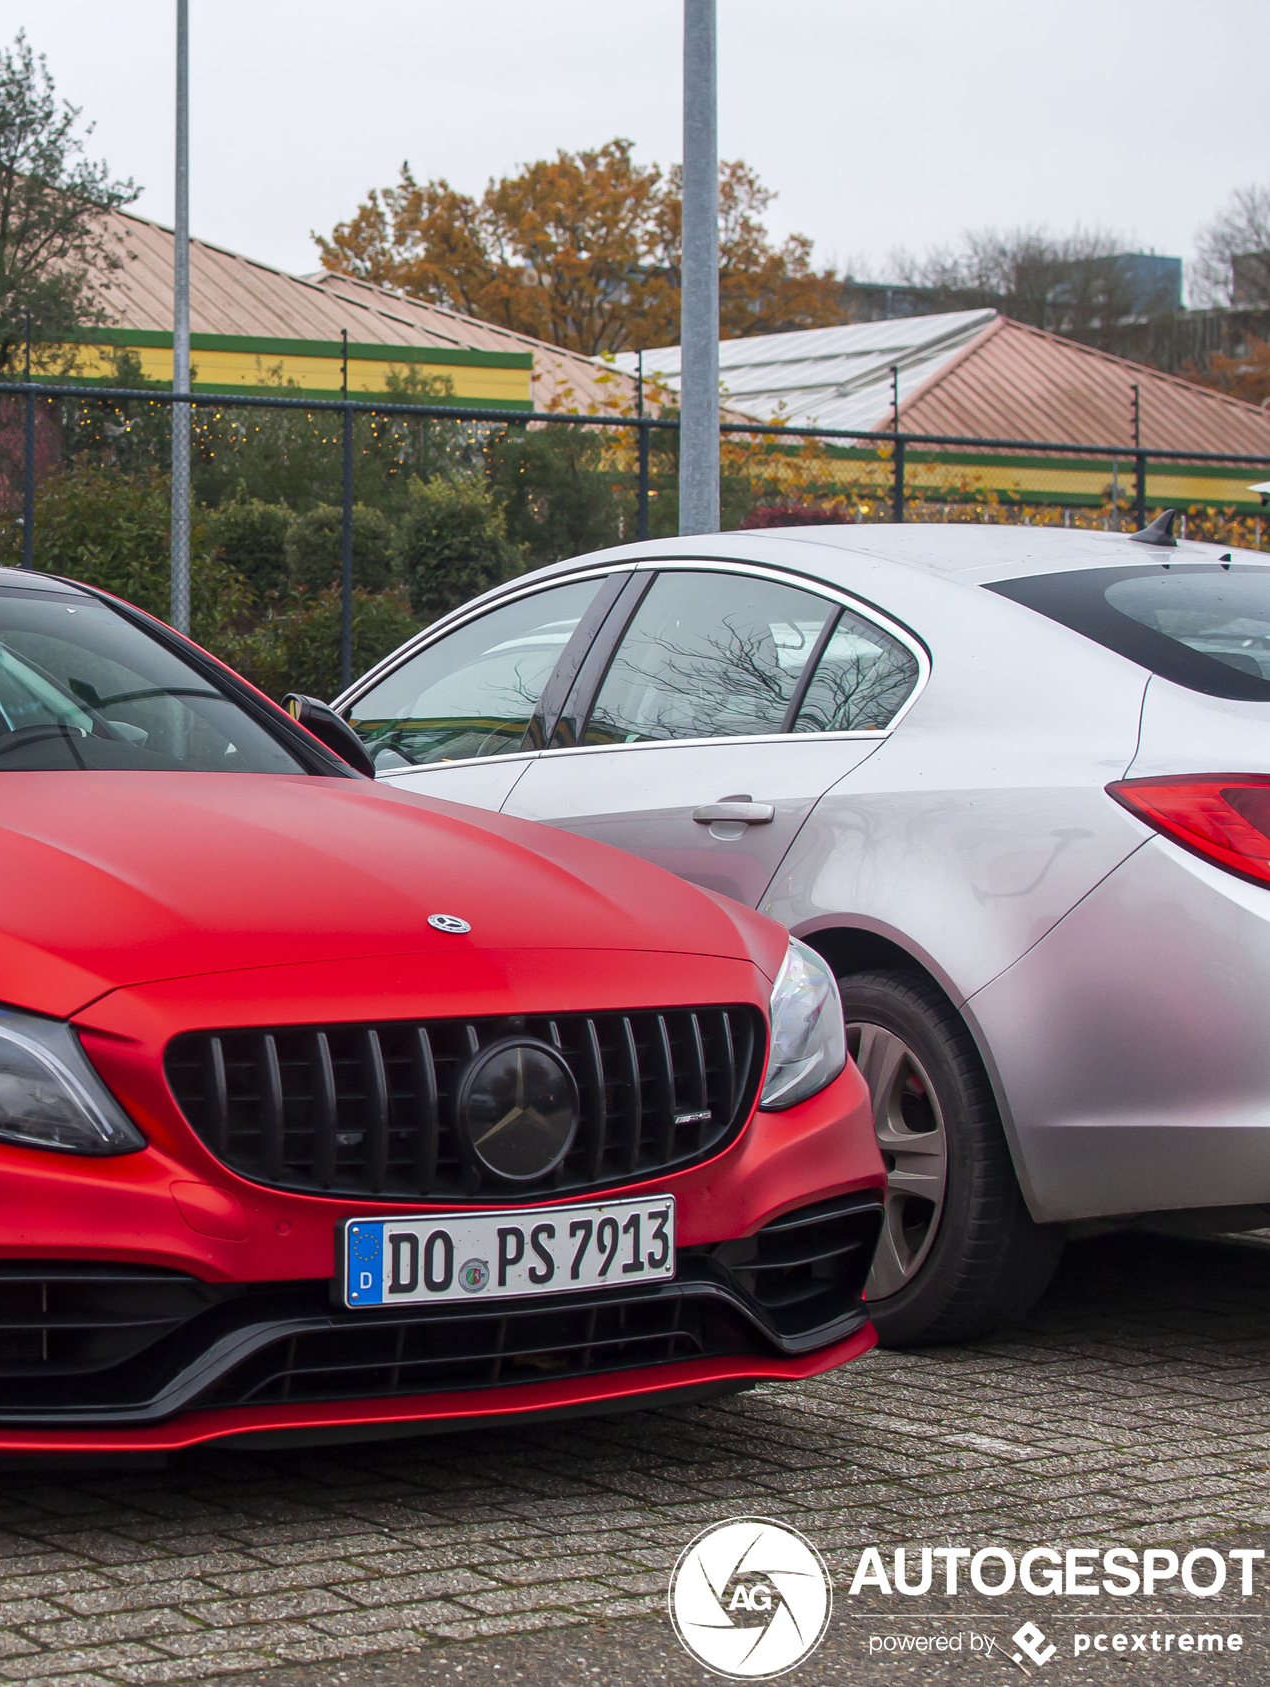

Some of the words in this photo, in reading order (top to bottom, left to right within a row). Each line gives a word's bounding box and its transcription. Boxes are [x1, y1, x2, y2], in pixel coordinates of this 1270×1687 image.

[388, 1229, 454, 1294] DO
[497, 1222, 557, 1287] PS
[569, 1209, 670, 1280] 7913
[360, 1272, 372, 1289] D
